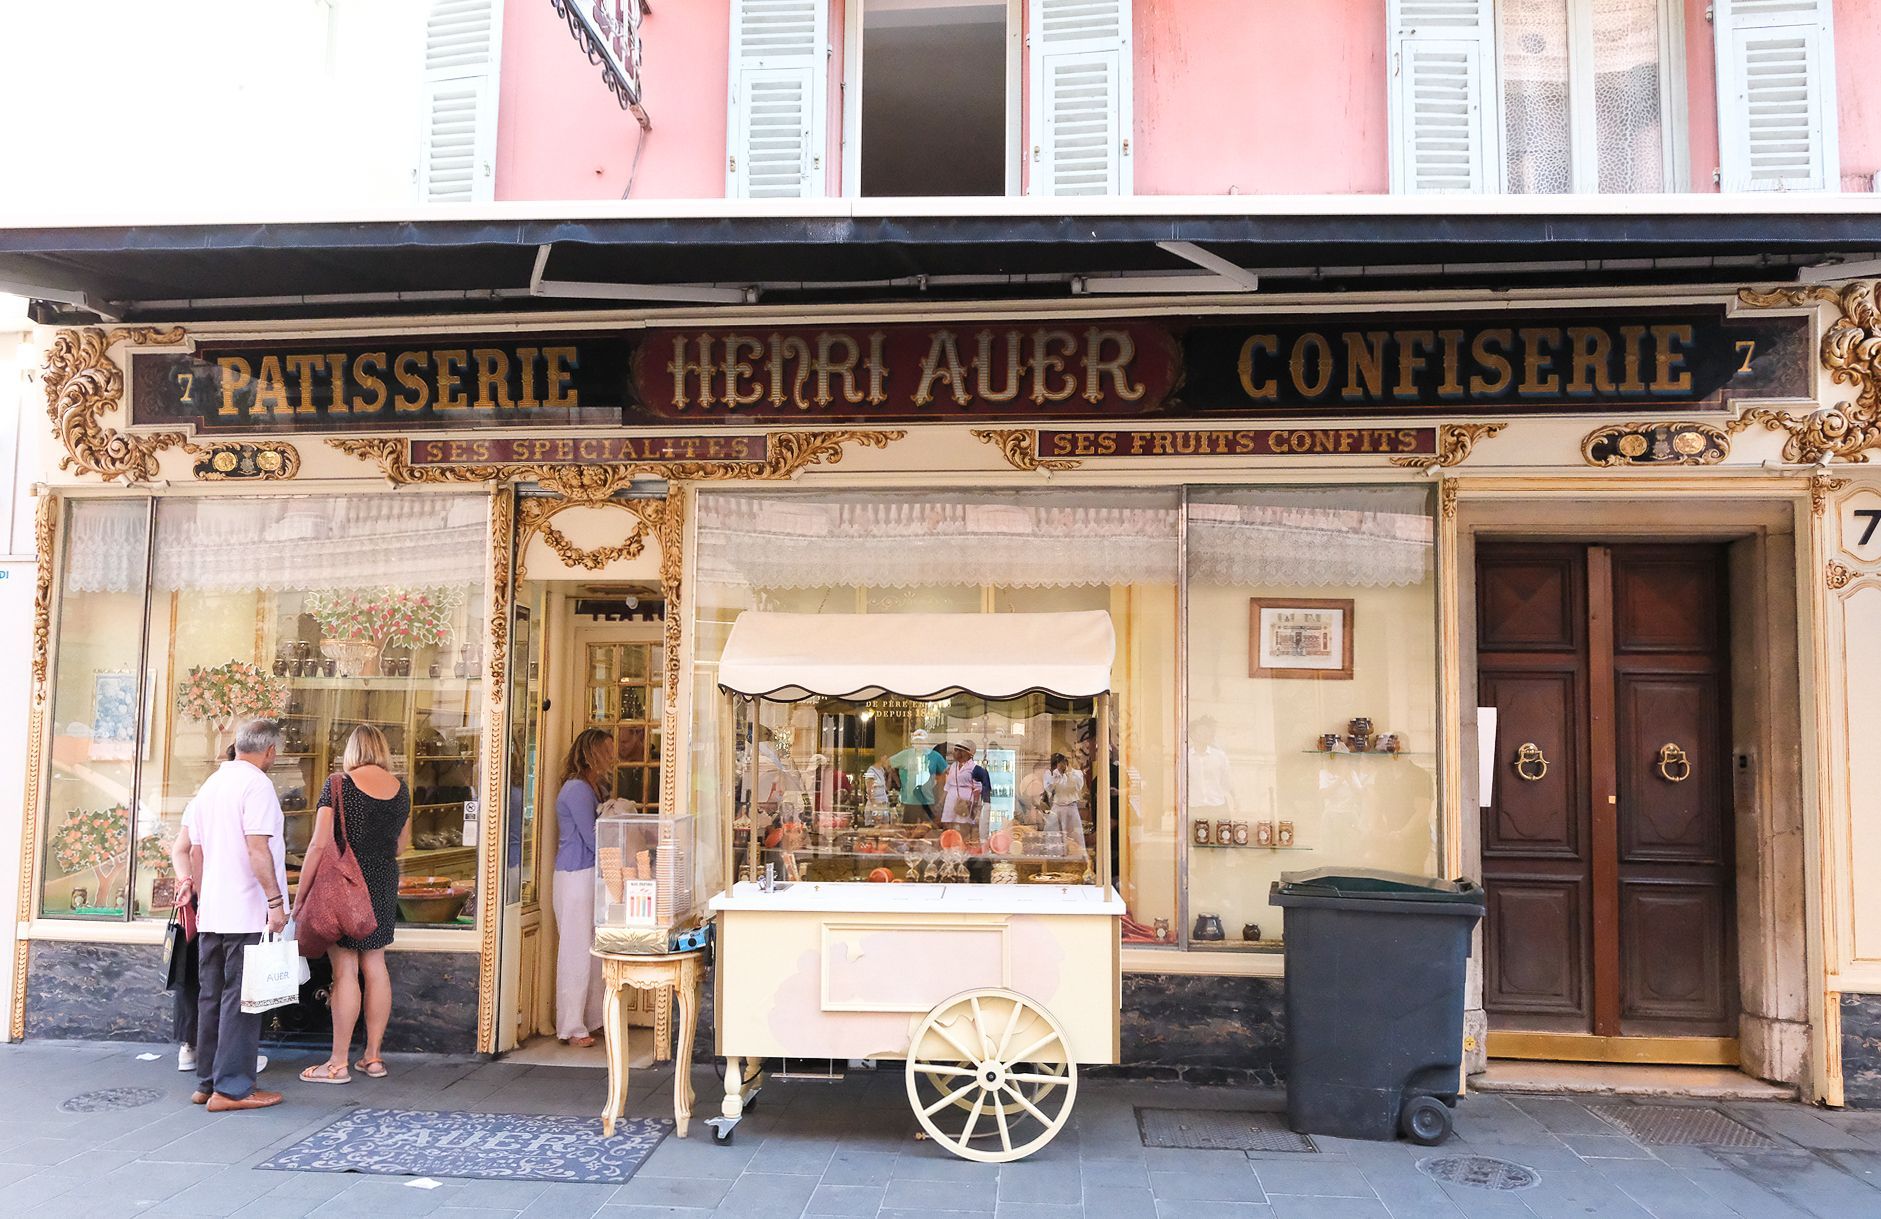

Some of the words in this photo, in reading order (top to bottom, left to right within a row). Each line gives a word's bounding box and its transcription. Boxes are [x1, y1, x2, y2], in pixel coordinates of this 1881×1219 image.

[667, 330, 888, 410] HENRI
[911, 326, 1145, 409] AUER
[1237, 325, 1694, 399] CONFISERIE
[1736, 341, 1755, 373] 7
[177, 373, 193, 402] 7
[217, 346, 579, 416] PATISSERIE
[427, 440, 490, 461] SES
[512, 437, 749, 460] SPECIALITES
[1054, 432, 1117, 454] SES
[1131, 431, 1255, 454] FRUITS
[1268, 429, 1418, 453] CONFITS
[1854, 509, 1881, 545] 7
[266, 971, 290, 983] AUER
